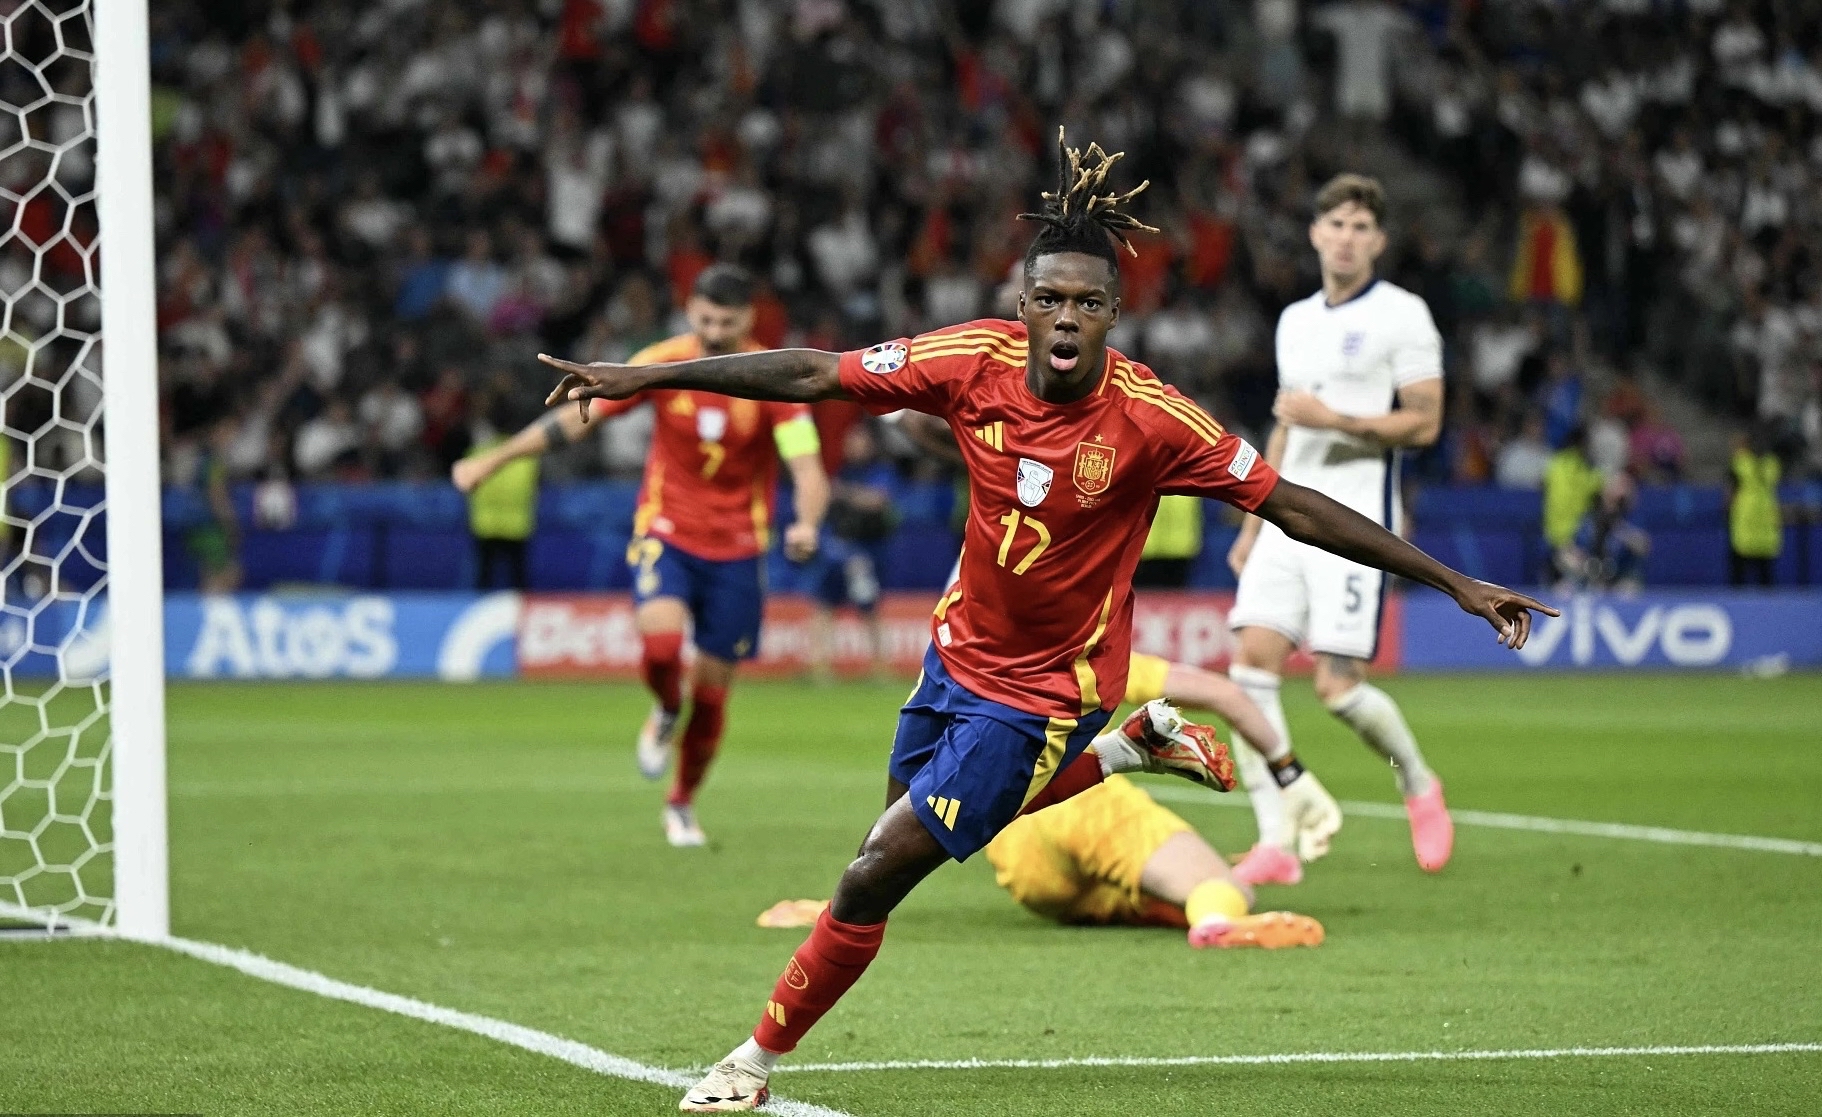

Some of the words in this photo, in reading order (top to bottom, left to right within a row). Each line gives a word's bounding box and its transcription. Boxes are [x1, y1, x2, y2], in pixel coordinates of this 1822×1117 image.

[699, 441, 726, 480] 7
[996, 508, 1051, 576] 17
[1343, 574, 1362, 614] 5
